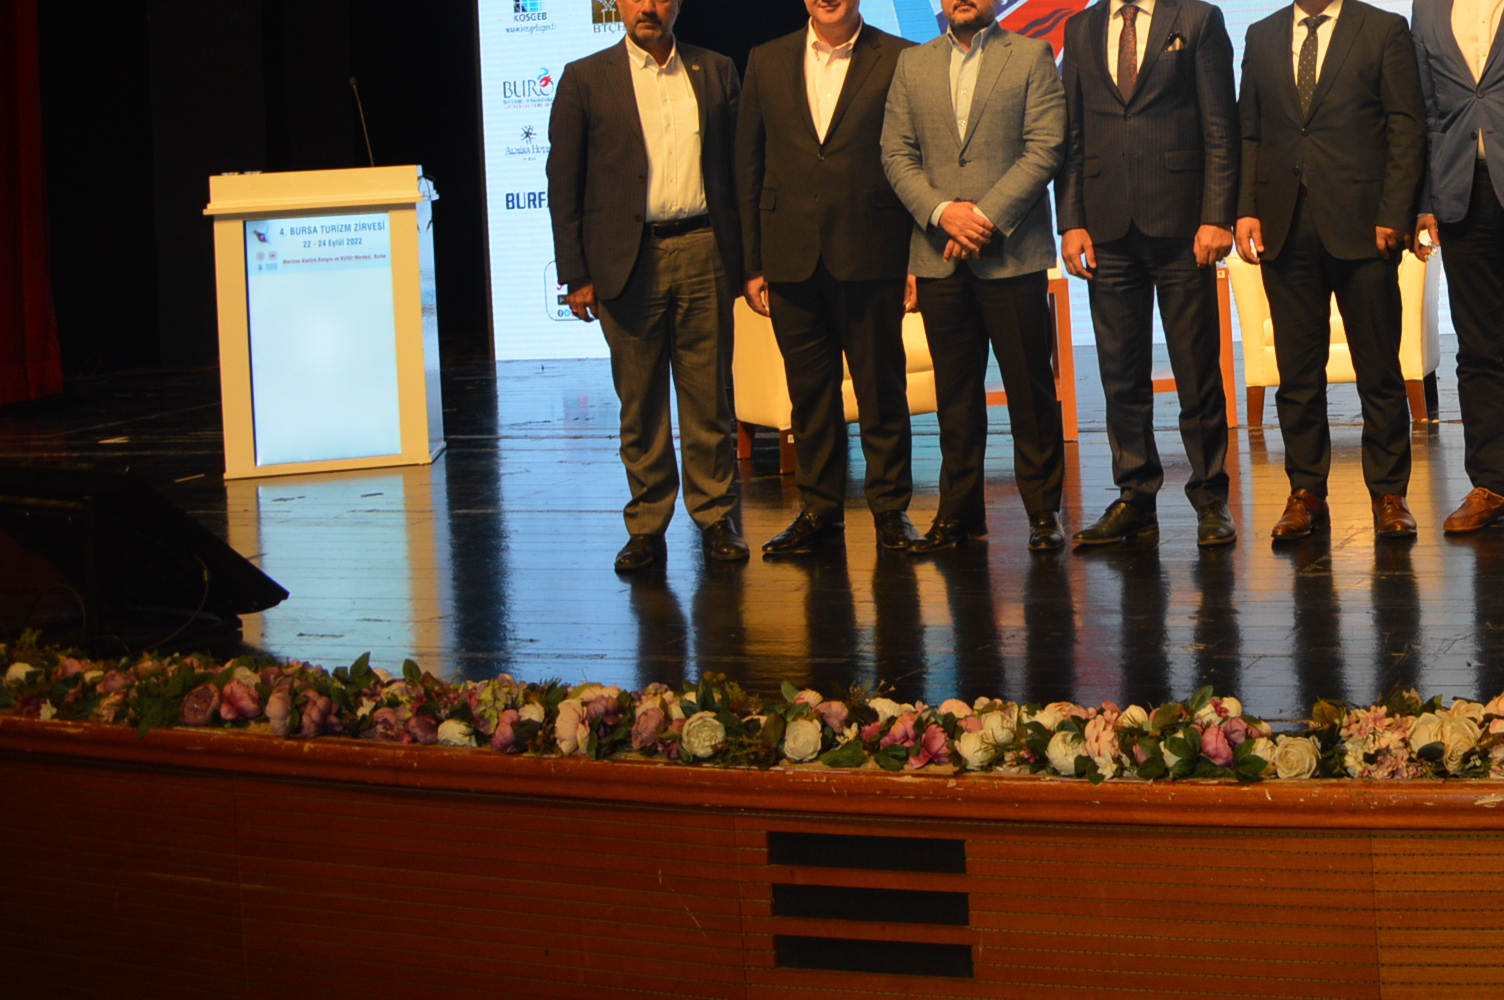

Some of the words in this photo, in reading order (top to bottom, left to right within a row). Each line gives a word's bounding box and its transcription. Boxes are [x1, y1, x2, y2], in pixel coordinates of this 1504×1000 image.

[514, 12, 547, 22] KOSGEB
[505, 191, 550, 210] BURF
[290, 225, 318, 236] BURSA
[320, 223, 351, 234] TURİZM
[354, 220, 385, 232] ZİRVESİ
[303, 240, 311, 248] 22
[318, 239, 327, 247] 24
[346, 237, 363, 246] 2022
